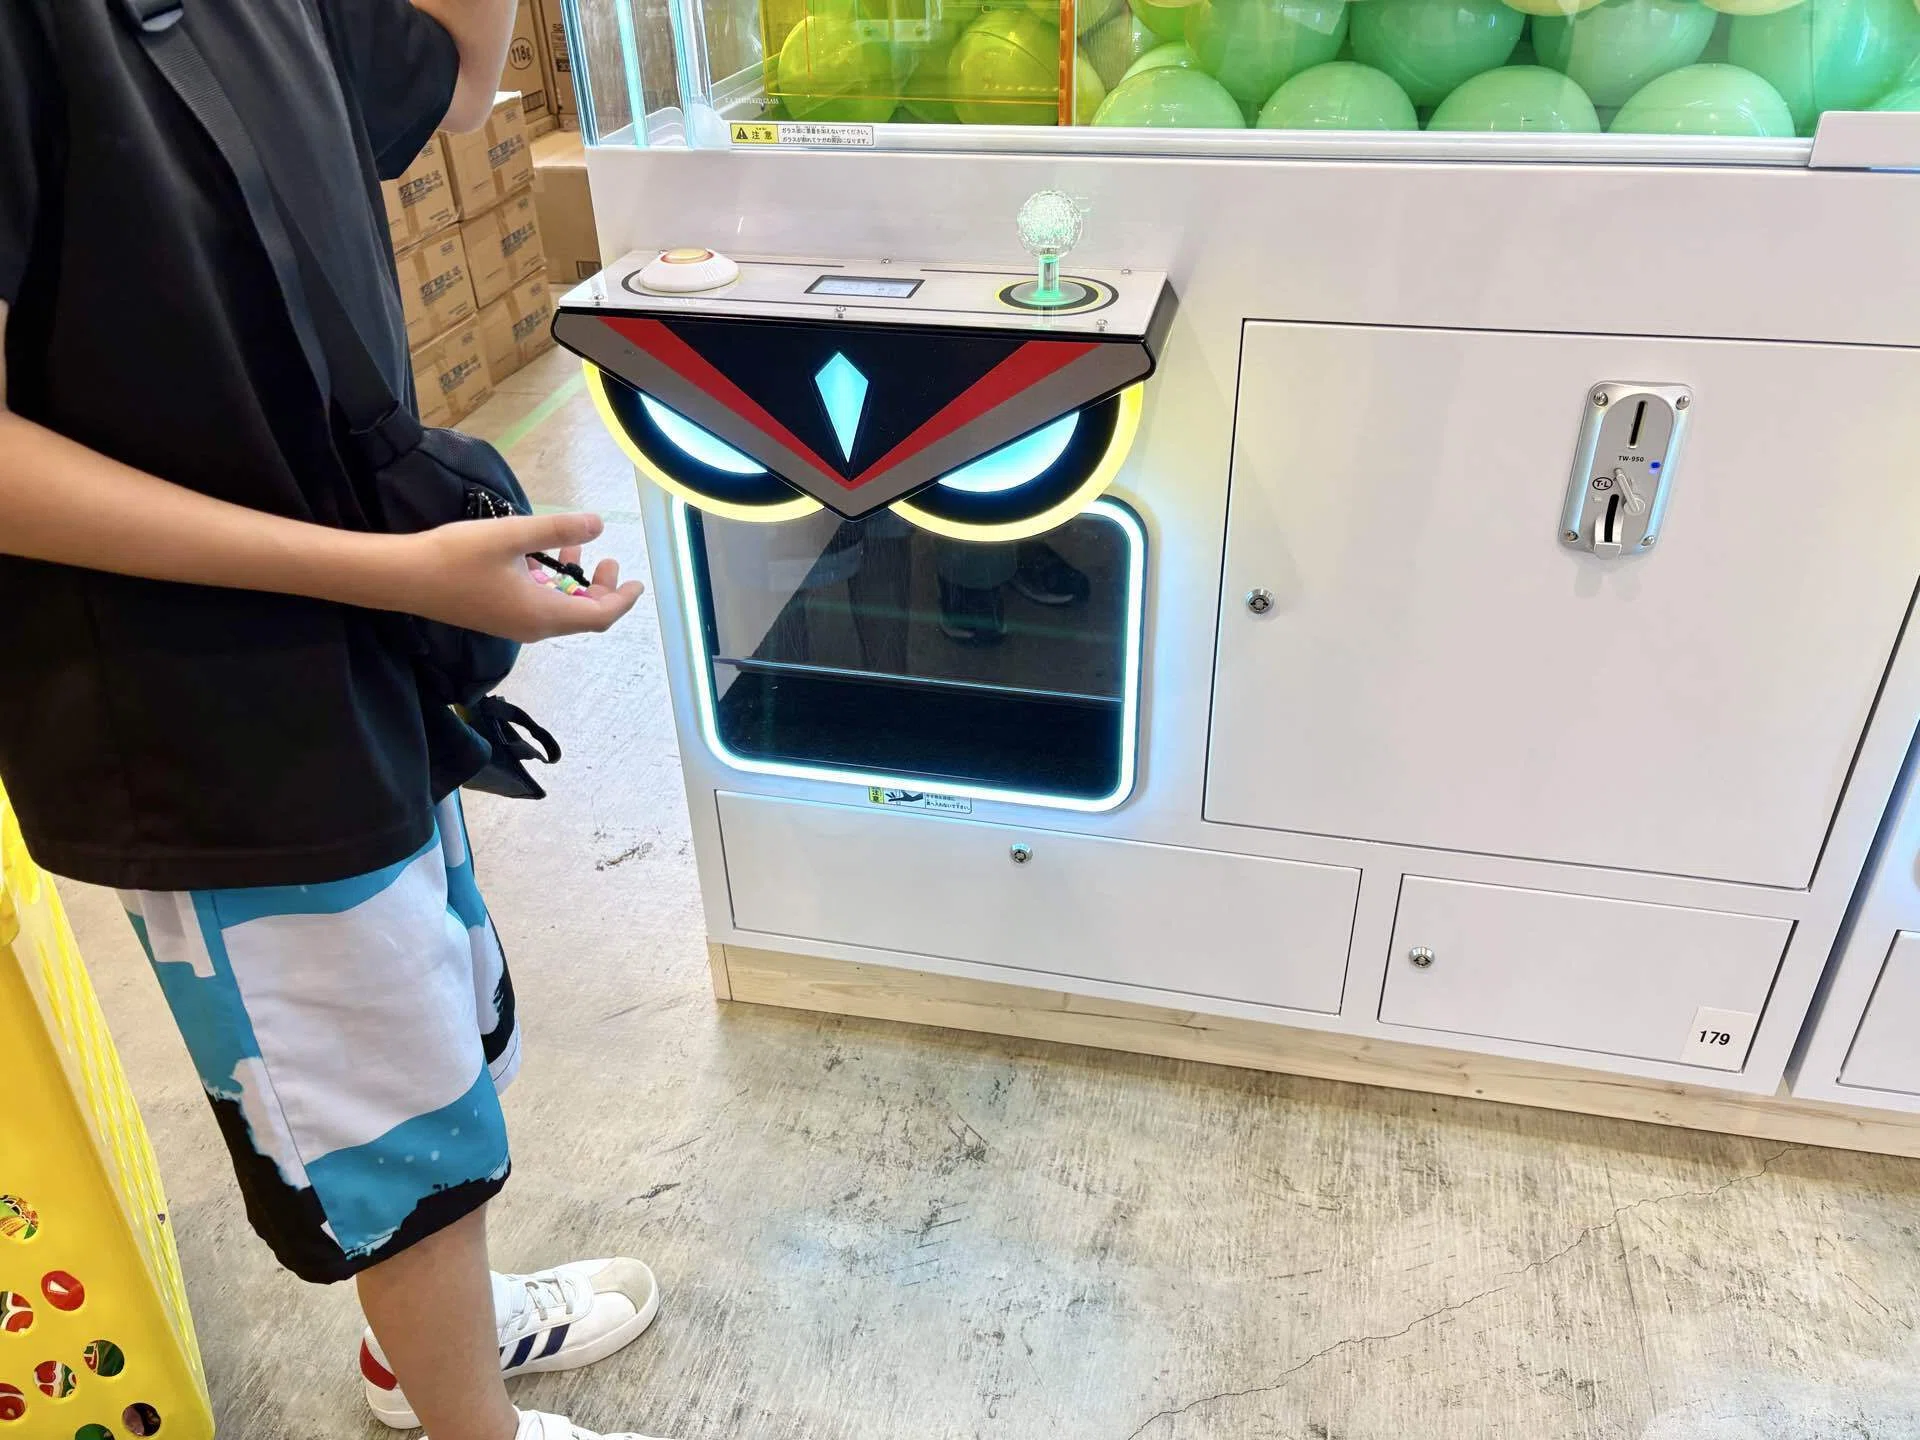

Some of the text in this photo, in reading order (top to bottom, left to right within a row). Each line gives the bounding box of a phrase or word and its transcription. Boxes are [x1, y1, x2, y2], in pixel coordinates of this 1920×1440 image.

[751, 129, 772, 140] 注意
[1618, 455, 1645, 463] TW-950
[1700, 1030, 1731, 1046] 179
